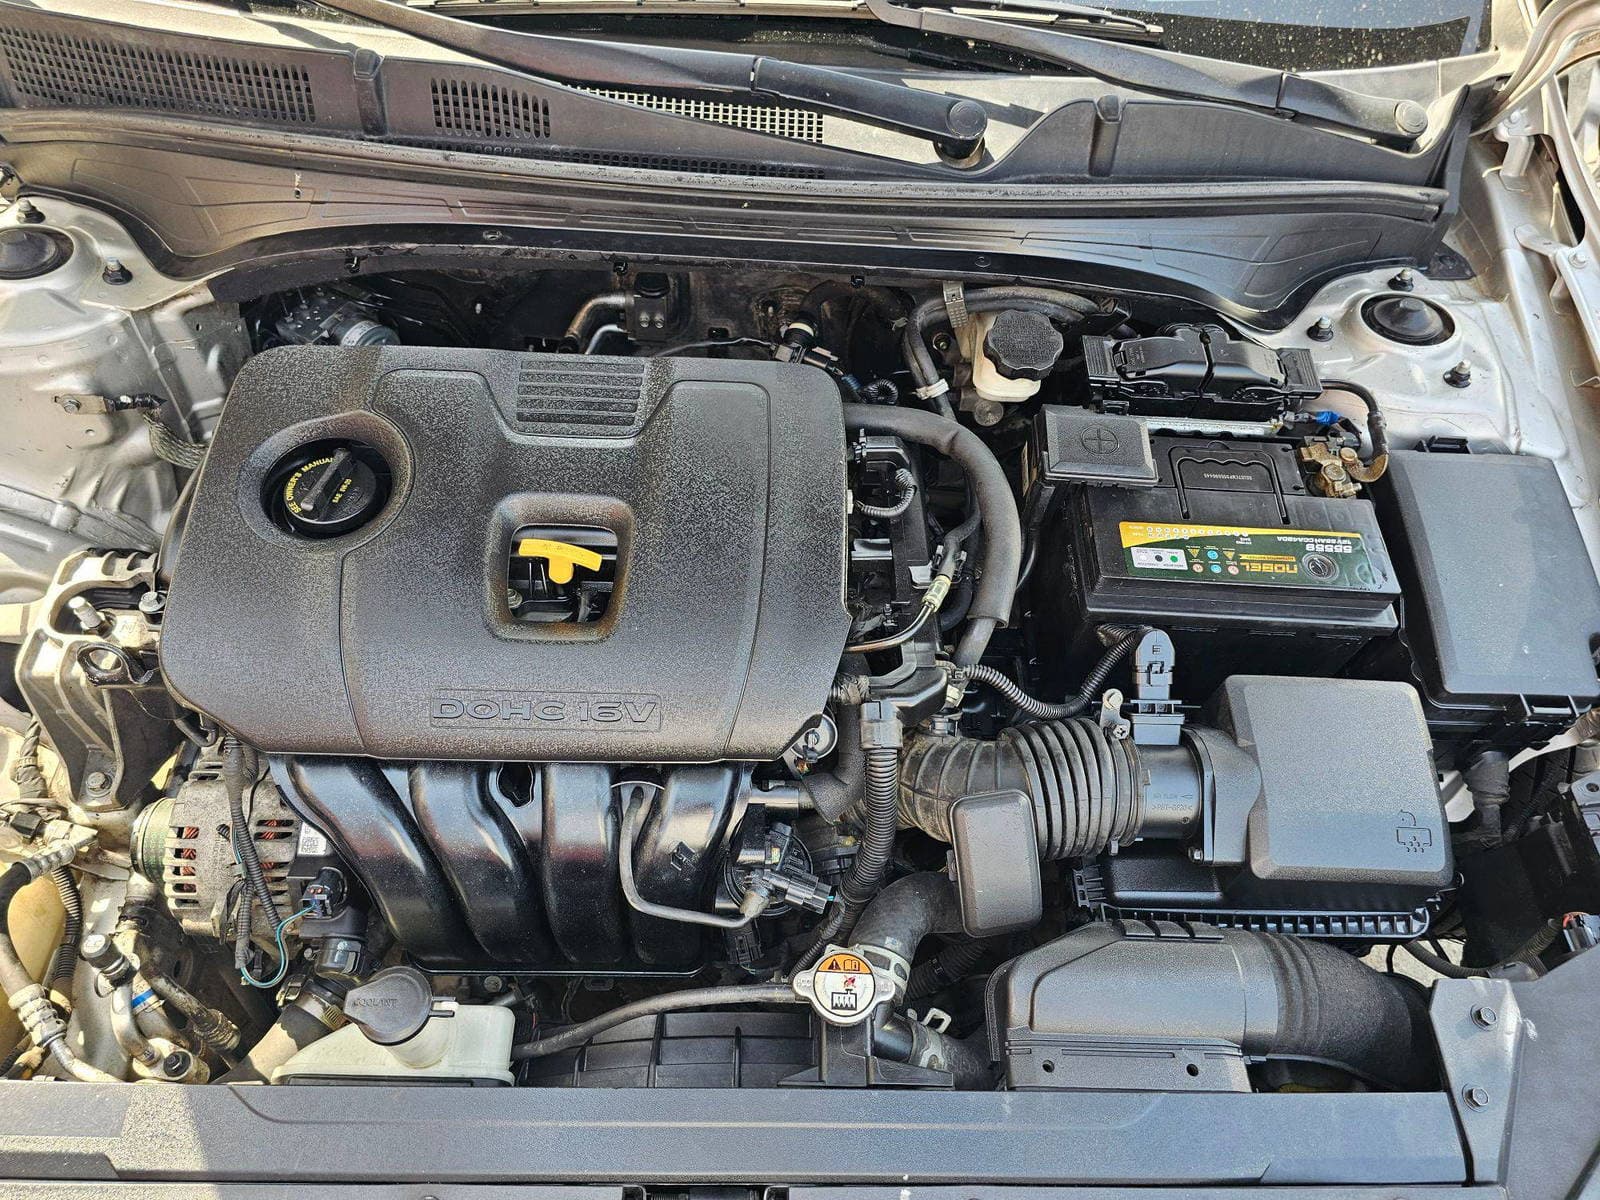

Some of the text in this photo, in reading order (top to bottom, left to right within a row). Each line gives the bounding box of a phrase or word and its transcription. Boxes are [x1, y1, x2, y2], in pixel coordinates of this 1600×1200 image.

[288, 501, 302, 513] SEE
[432, 698, 658, 723] DOHC 16V
